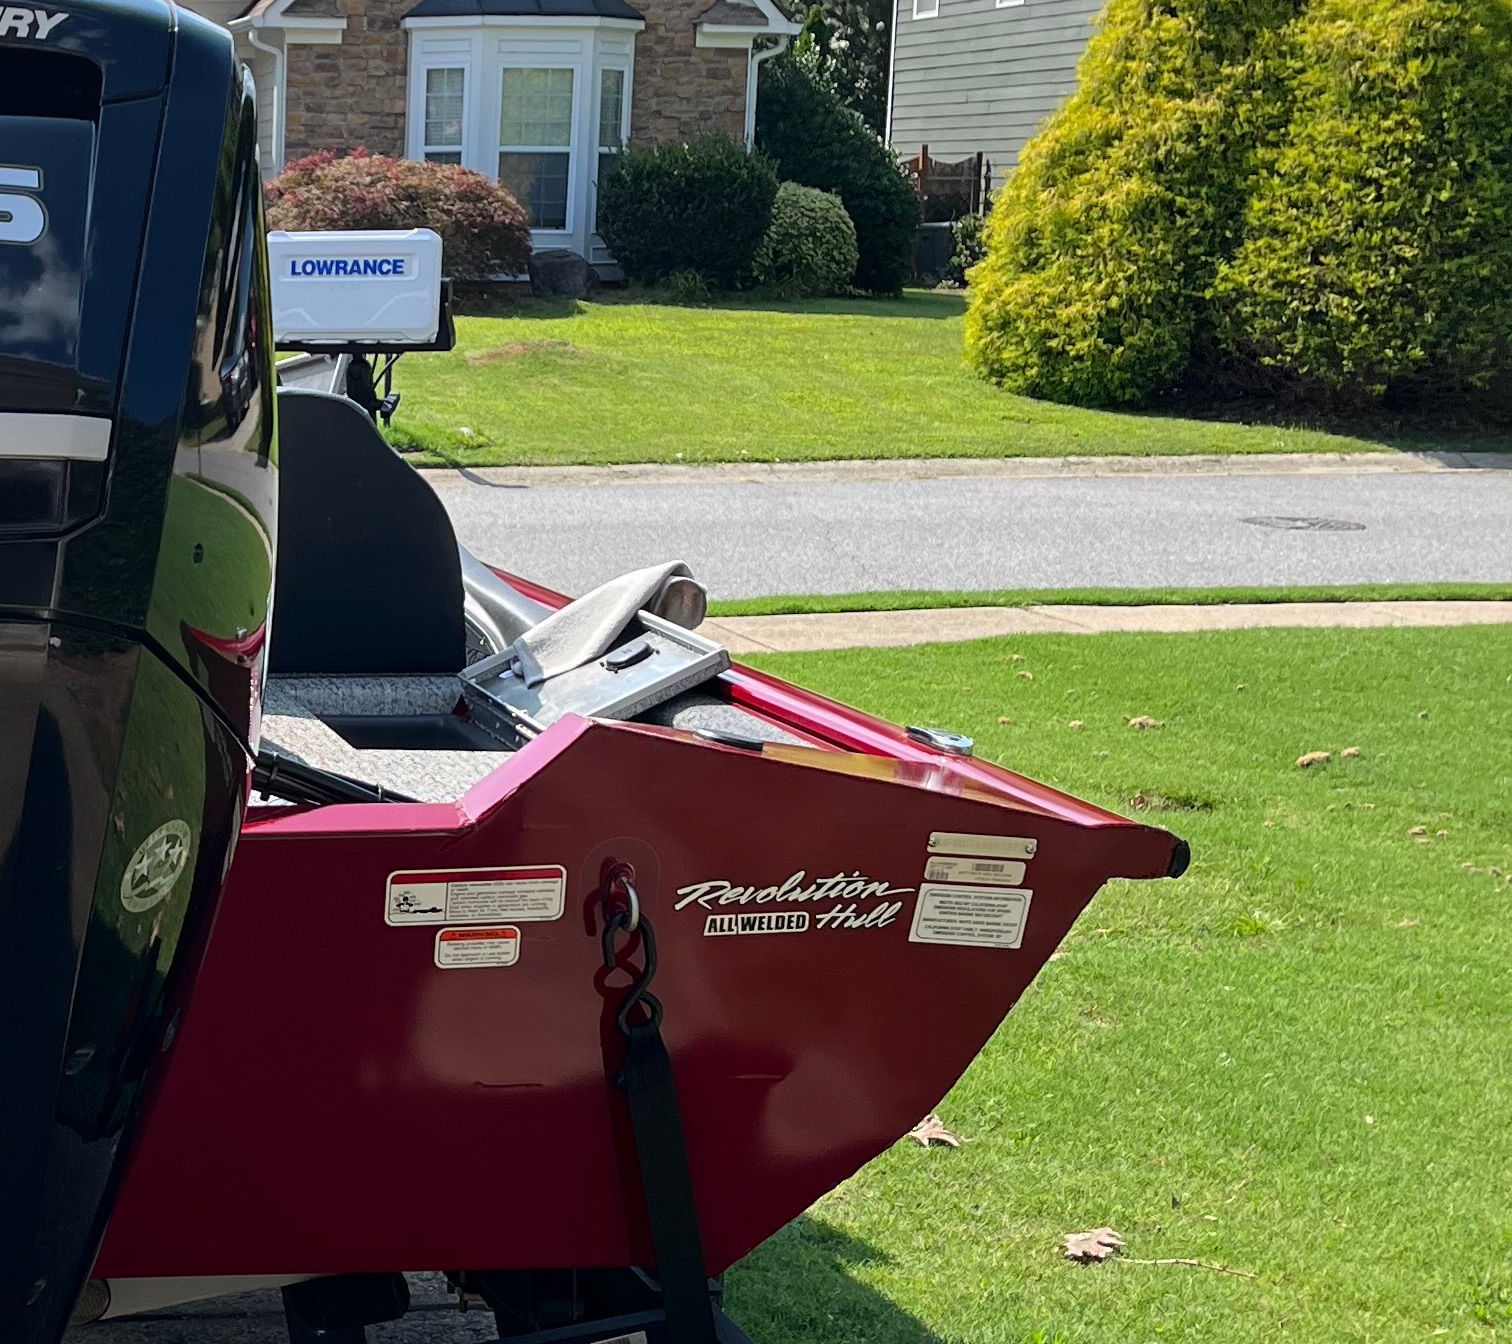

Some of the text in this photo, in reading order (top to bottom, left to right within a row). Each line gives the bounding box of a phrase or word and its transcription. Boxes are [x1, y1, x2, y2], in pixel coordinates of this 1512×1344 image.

[290, 258, 405, 276] LOWRANCE
[674, 871, 916, 910] Revolution
[707, 914, 807, 933] ALL WELDED
[814, 901, 902, 929] Hull
